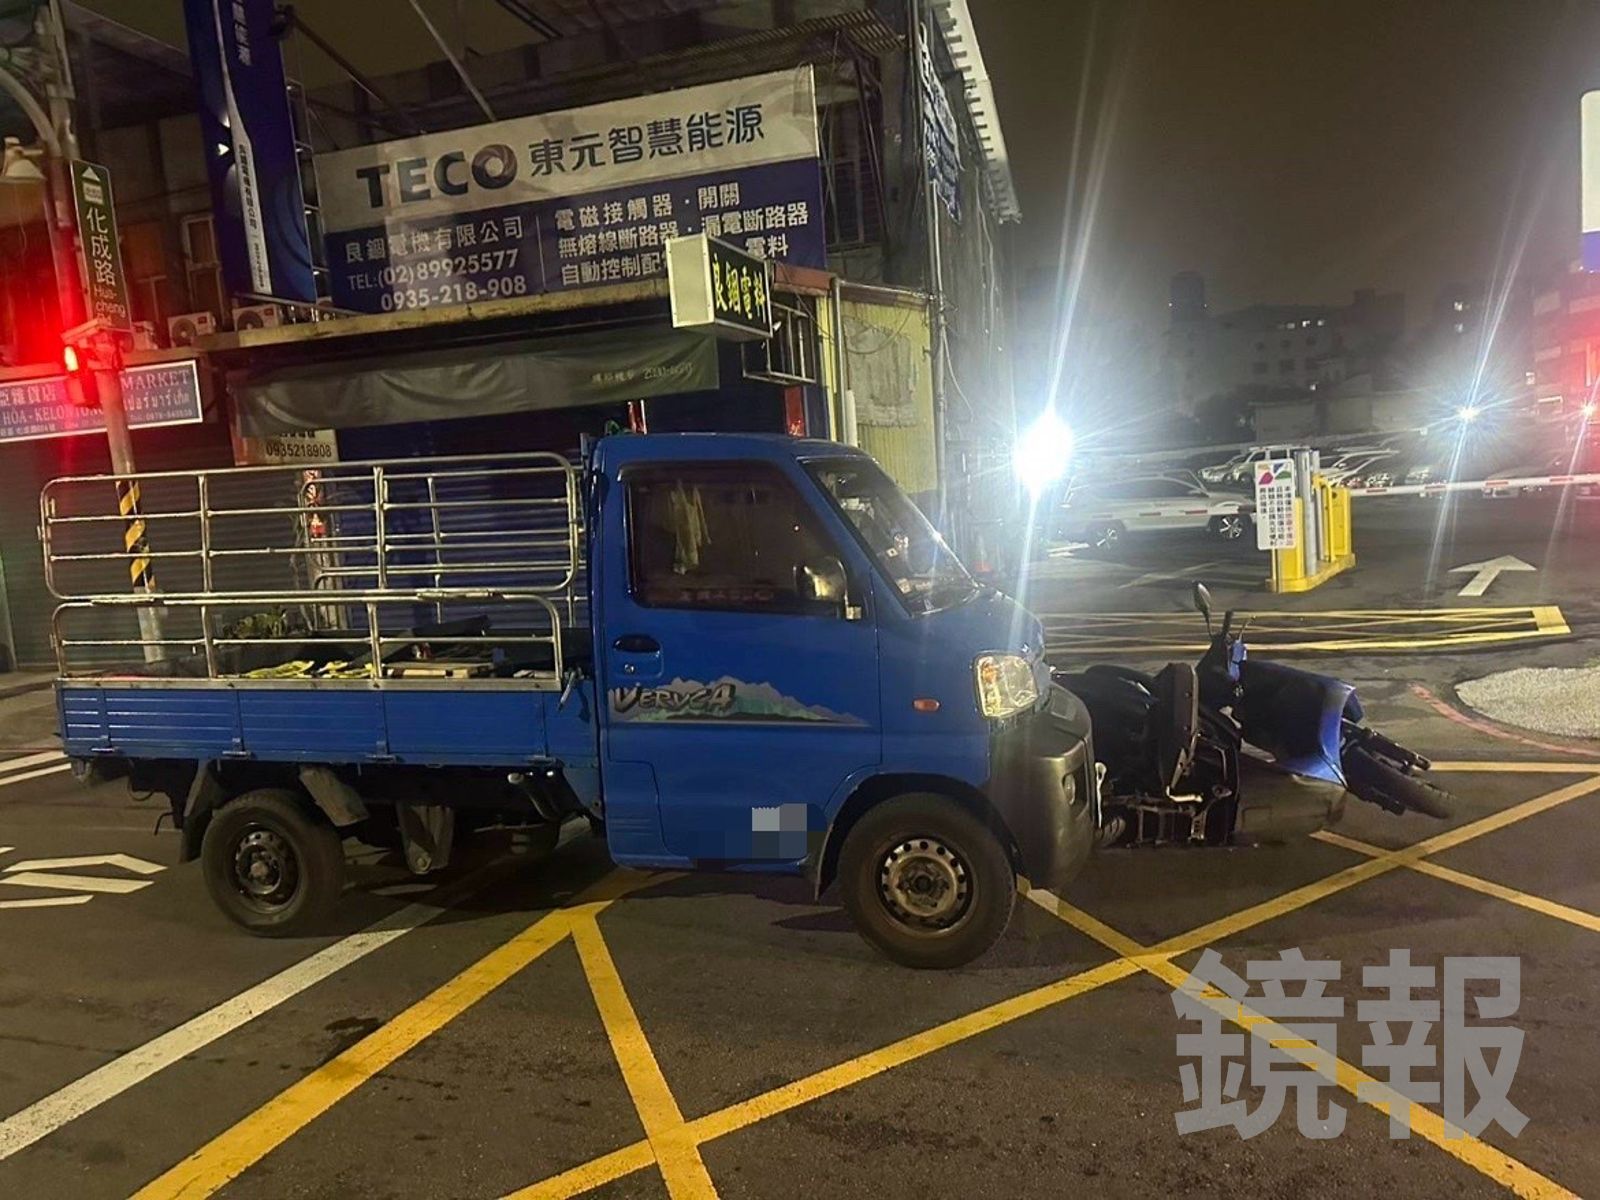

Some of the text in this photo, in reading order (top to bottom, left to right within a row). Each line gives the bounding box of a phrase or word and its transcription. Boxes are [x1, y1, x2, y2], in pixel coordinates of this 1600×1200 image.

[356, 104, 765, 209] TECO 東元智慧能源
[86, 206, 116, 288] 化成路
[380, 275, 528, 313] 0935-218-908
[121, 369, 191, 391] MARKET
[265, 440, 332, 460] 0935218908
